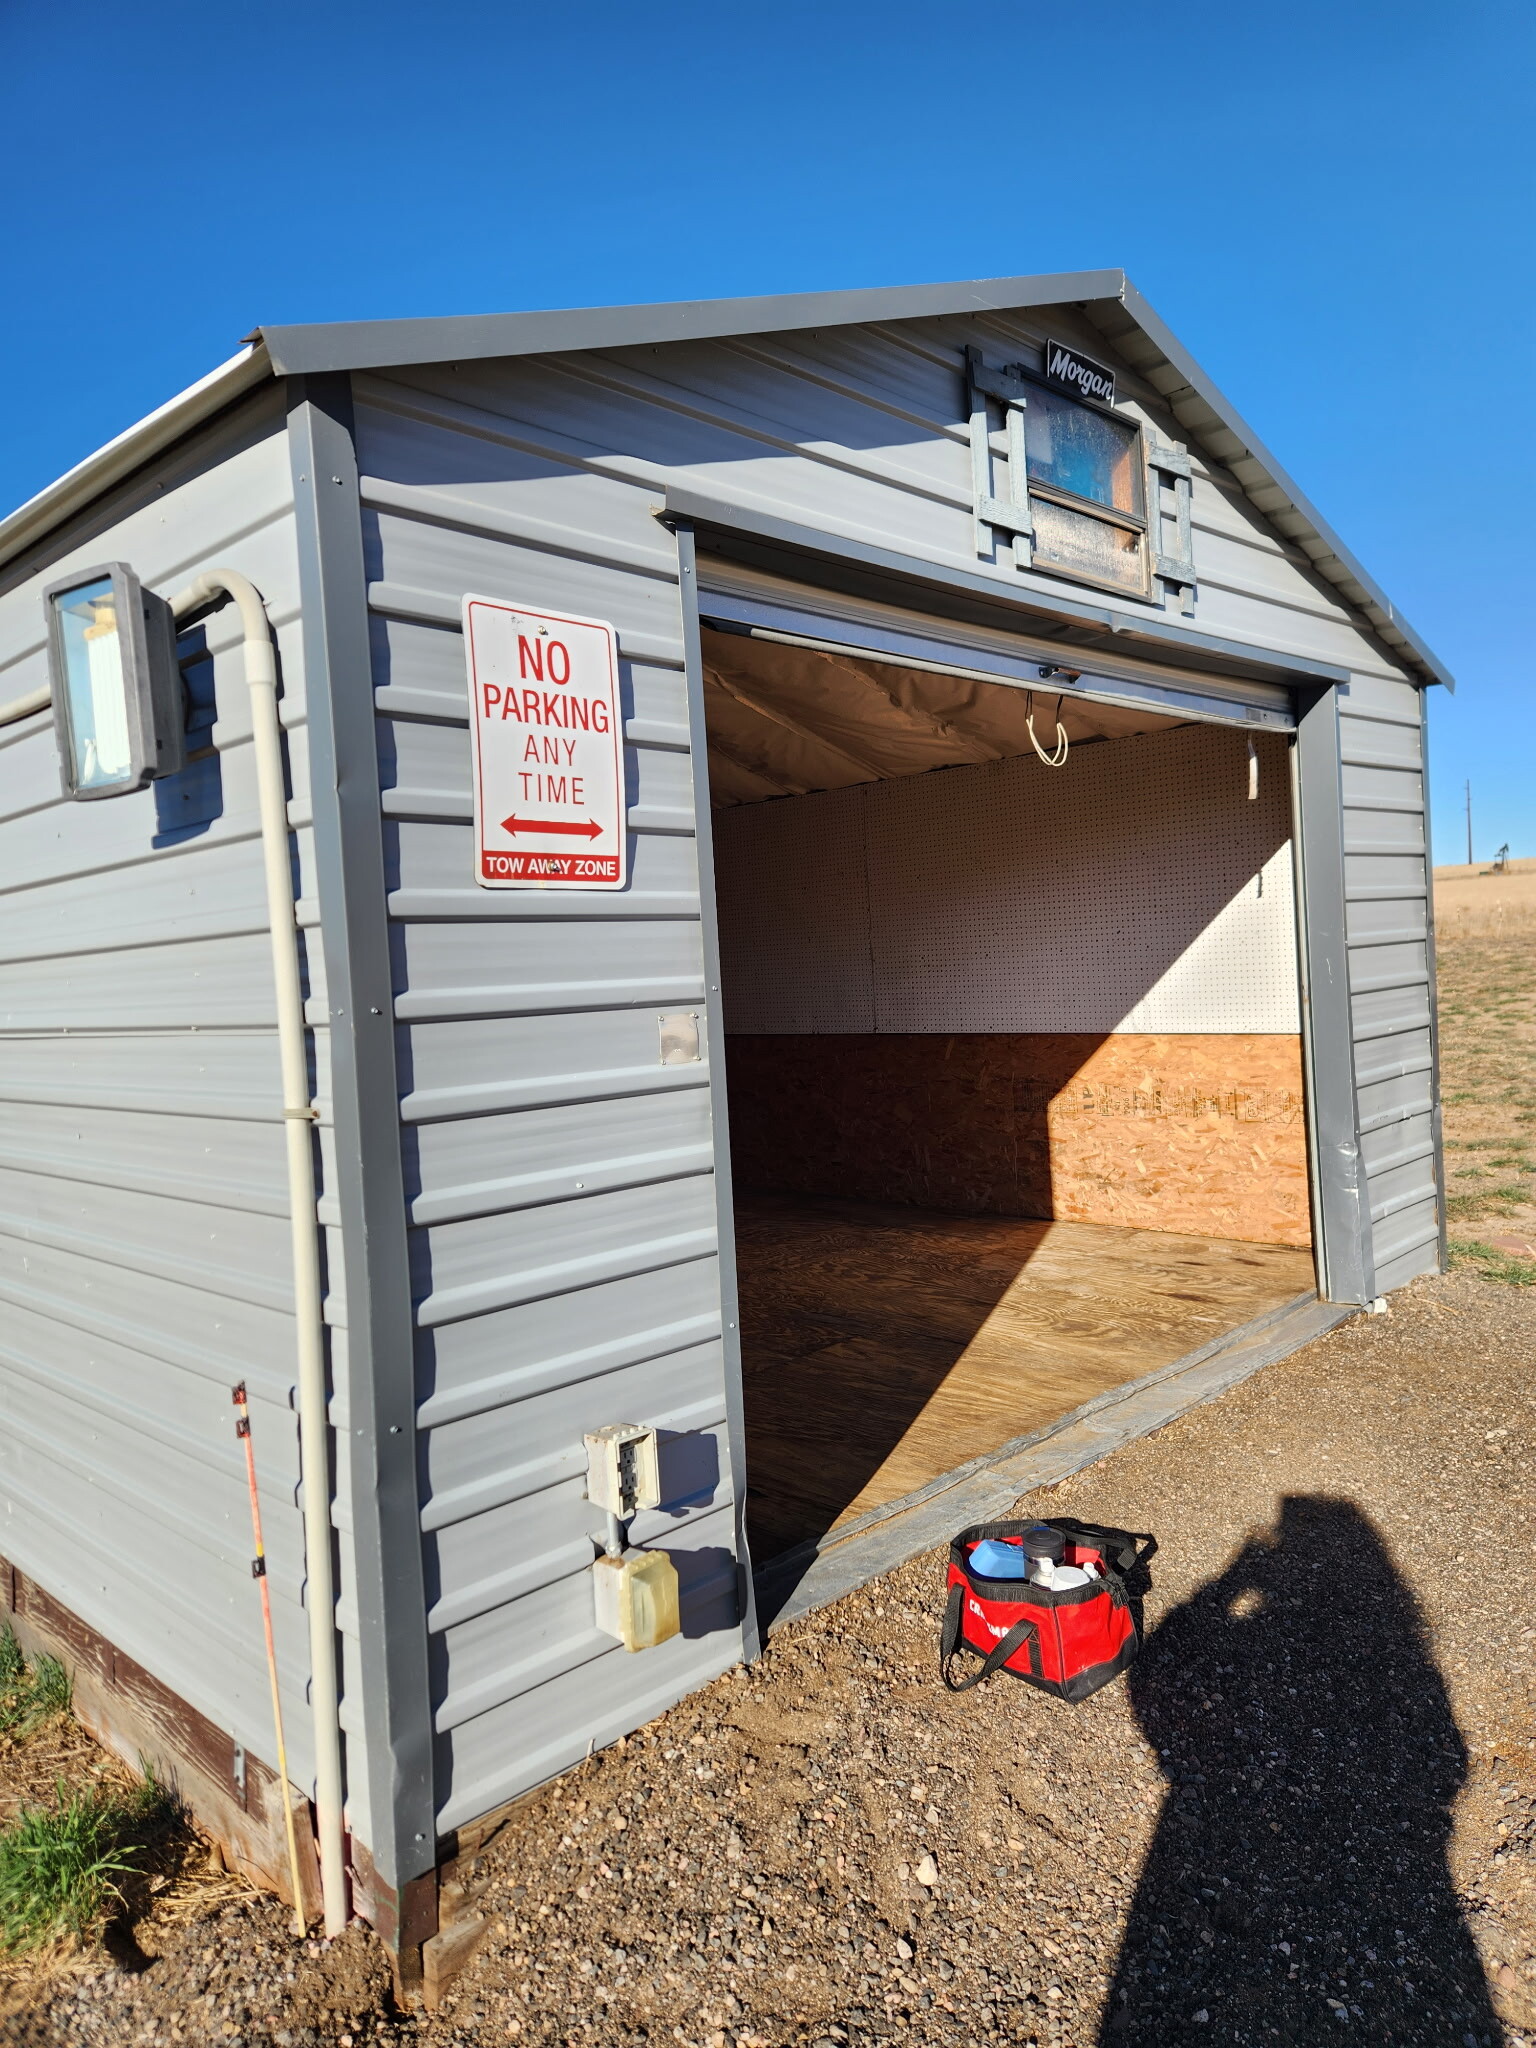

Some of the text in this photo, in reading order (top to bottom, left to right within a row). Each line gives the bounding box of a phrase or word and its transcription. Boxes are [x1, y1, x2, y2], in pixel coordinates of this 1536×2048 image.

[1050, 348, 1113, 400] Morgan
[518, 634, 571, 685] NO
[483, 683, 610, 733] PARKING
[524, 734, 577, 767] ANY
[518, 772, 585, 805] TIME
[486, 856, 617, 876] TOW AWAY ZONE
